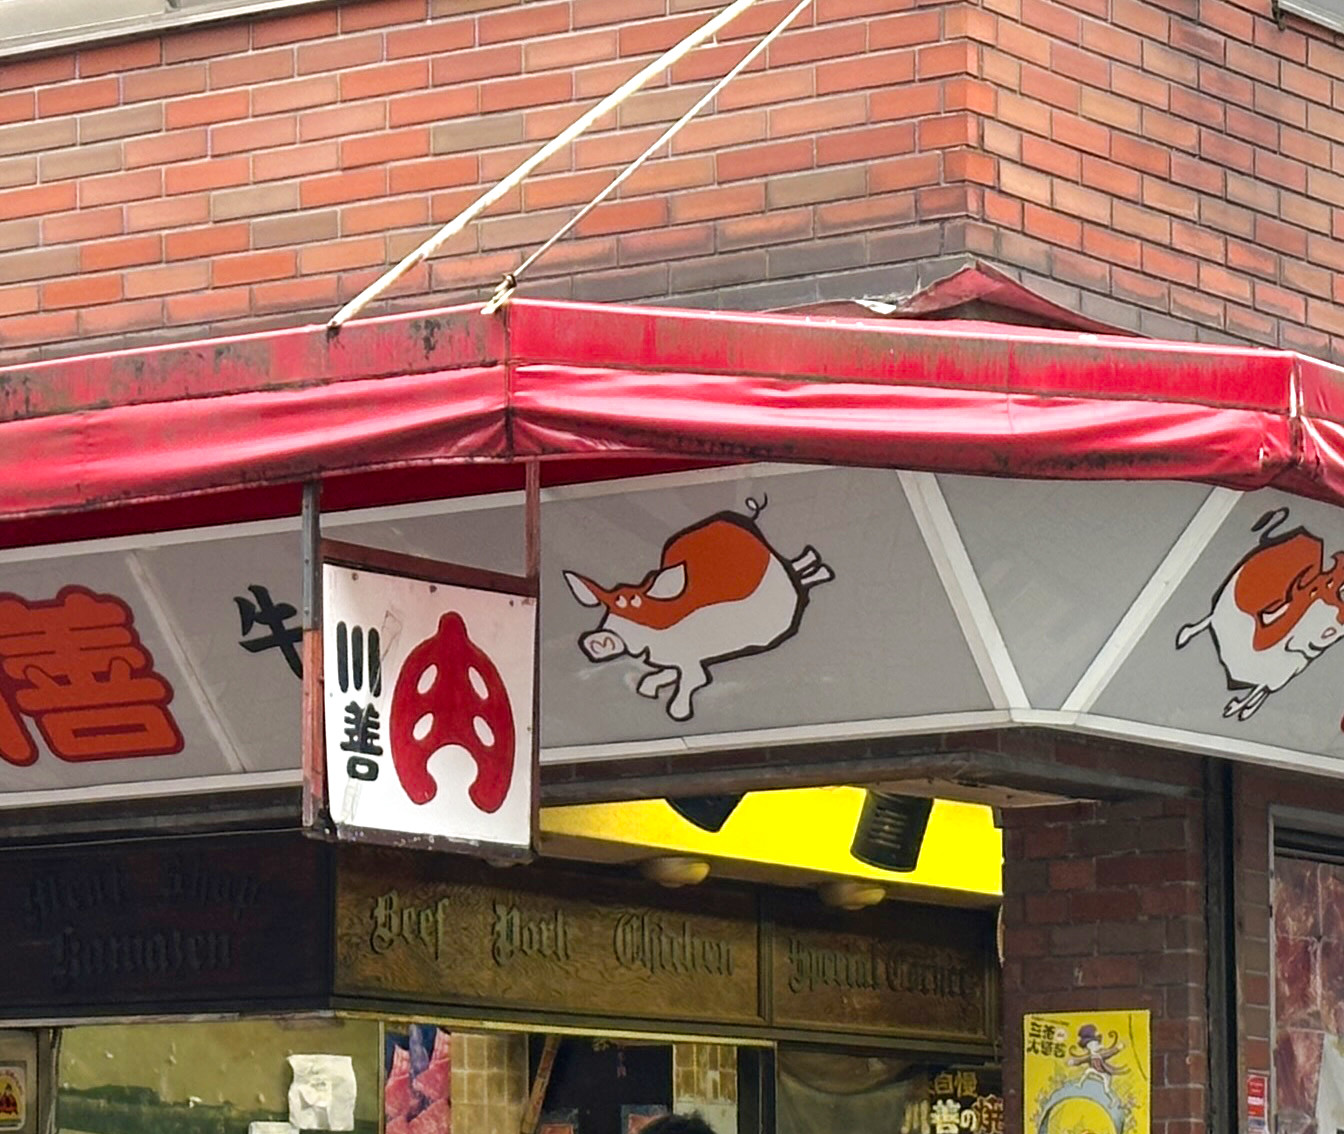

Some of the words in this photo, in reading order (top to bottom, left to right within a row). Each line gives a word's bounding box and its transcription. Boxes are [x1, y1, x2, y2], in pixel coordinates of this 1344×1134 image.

[233, 585, 304, 679] 牛
[336, 620, 384, 781] 川善
[370, 889, 449, 960] Beef
[492, 900, 570, 966] Pork
[613, 912, 735, 976] Chicken
[788, 939, 879, 995] Special
